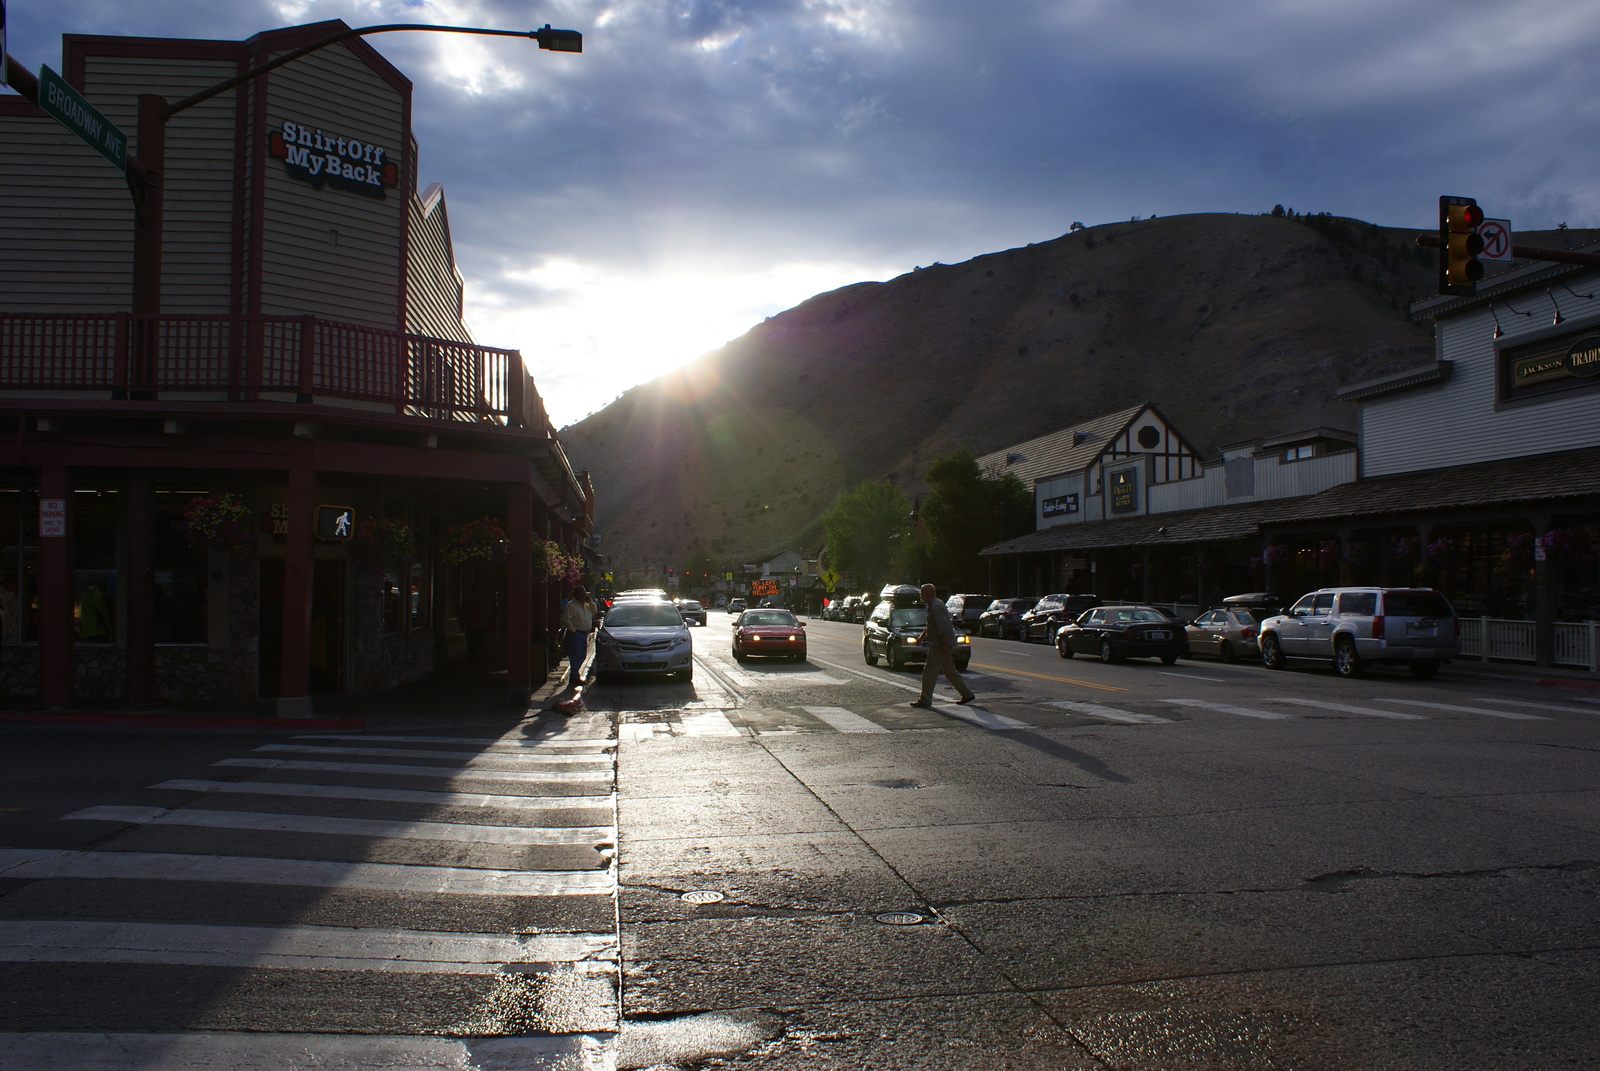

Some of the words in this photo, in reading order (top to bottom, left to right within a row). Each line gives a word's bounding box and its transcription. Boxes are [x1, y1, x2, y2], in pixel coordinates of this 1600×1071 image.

[48, 81, 102, 141] BROADWAY
[104, 131, 122, 159] AVE
[282, 121, 385, 166] ShirtOff
[285, 143, 382, 187] MyBack
[1523, 360, 1564, 377] JACKSON
[41, 510, 64, 518] PARKING
[48, 501, 58, 509] NO
